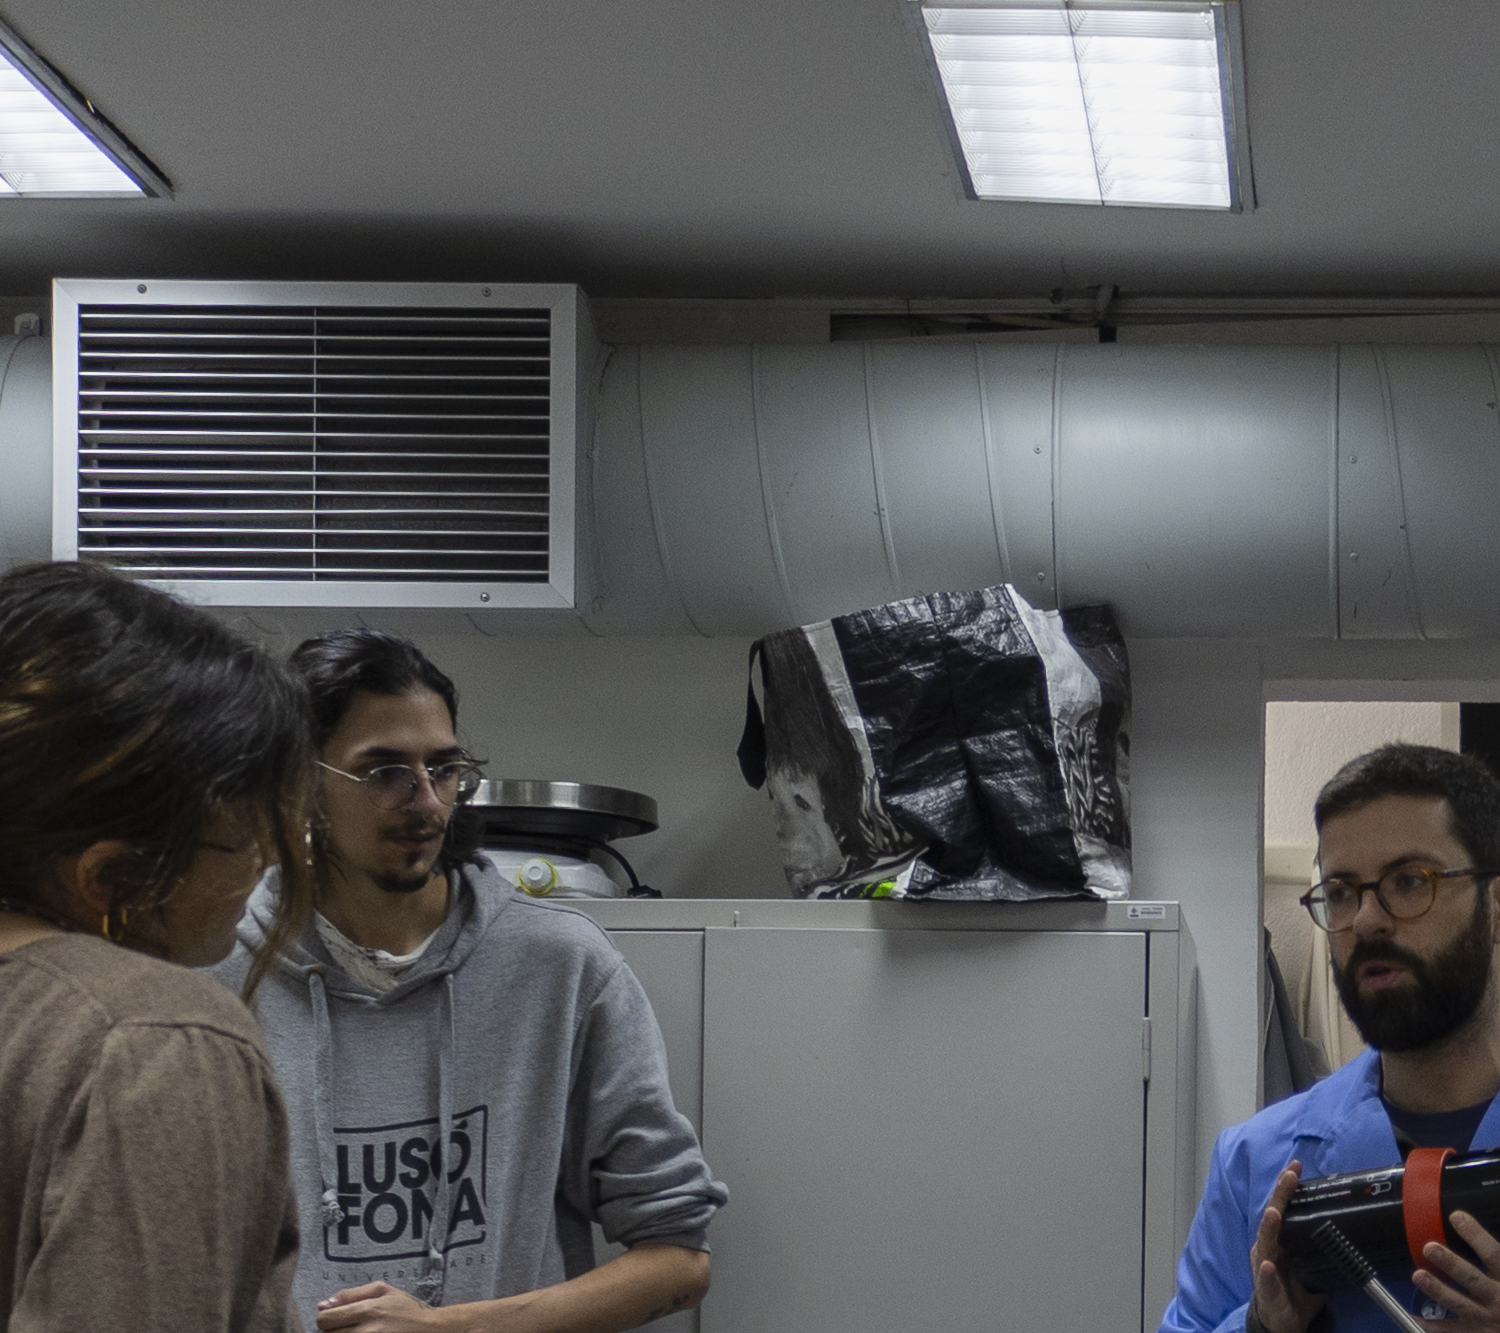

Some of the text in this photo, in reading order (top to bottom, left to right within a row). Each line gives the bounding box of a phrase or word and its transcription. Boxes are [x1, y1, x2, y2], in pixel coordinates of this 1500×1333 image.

[336, 1118, 472, 1196] LUSÓ
[337, 1177, 486, 1246] FONA
[323, 1252, 487, 1284] UNIVERSADE
